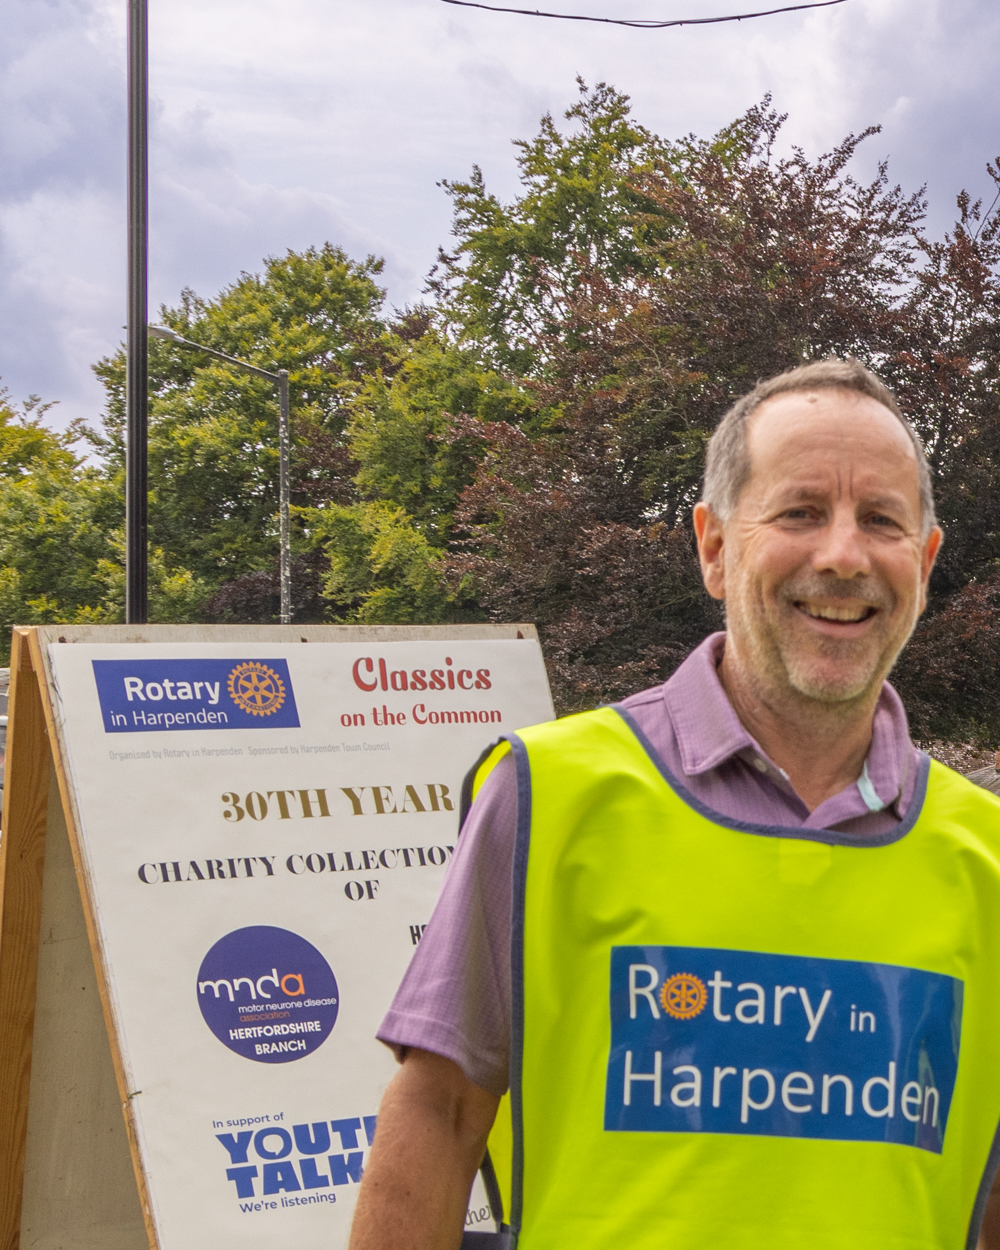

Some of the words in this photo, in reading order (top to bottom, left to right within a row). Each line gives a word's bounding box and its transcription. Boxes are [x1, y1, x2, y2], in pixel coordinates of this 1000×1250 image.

[352, 657, 492, 692] Classics
[123, 676, 220, 705] Rotary
[110, 711, 127, 726] in
[133, 708, 228, 728] Harpenden
[340, 712, 365, 727] on
[371, 705, 407, 726] the
[412, 703, 502, 725] Common
[109, 749, 150, 761] Organised
[152, 749, 162, 760] by
[163, 748, 190, 759] Rotary
[192, 748, 200, 758] in
[202, 746, 243, 758] Harpenden
[249, 745, 289, 757] Sponsored
[290, 745, 299, 756] by
[300, 743, 340, 755] Harpenden
[341, 742, 362, 752] Town
[363, 741, 391, 752] Council
[221, 788, 333, 823] 30TH
[338, 783, 456, 816] YEAR
[137, 855, 277, 884] CHARITY
[344, 880, 380, 901] OF
[199, 968, 305, 1002] mnda
[238, 1003, 264, 1014] motor
[266, 1000, 302, 1011] neurone
[303, 998, 337, 1008] disease
[628, 963, 832, 1042] Rotary
[850, 1003, 876, 1033] in
[240, 1011, 290, 1022] association
[229, 1021, 322, 1040] HERTFORDSHIRE
[254, 1039, 307, 1055] BRANCH
[623, 1050, 940, 1128] Harpenden
[212, 1120, 224, 1129] In
[226, 1113, 271, 1128] support
[273, 1112, 285, 1122] of
[225, 1151, 365, 1199] TALK
[239, 1200, 278, 1213] We're
[281, 1192, 337, 1208] listening
